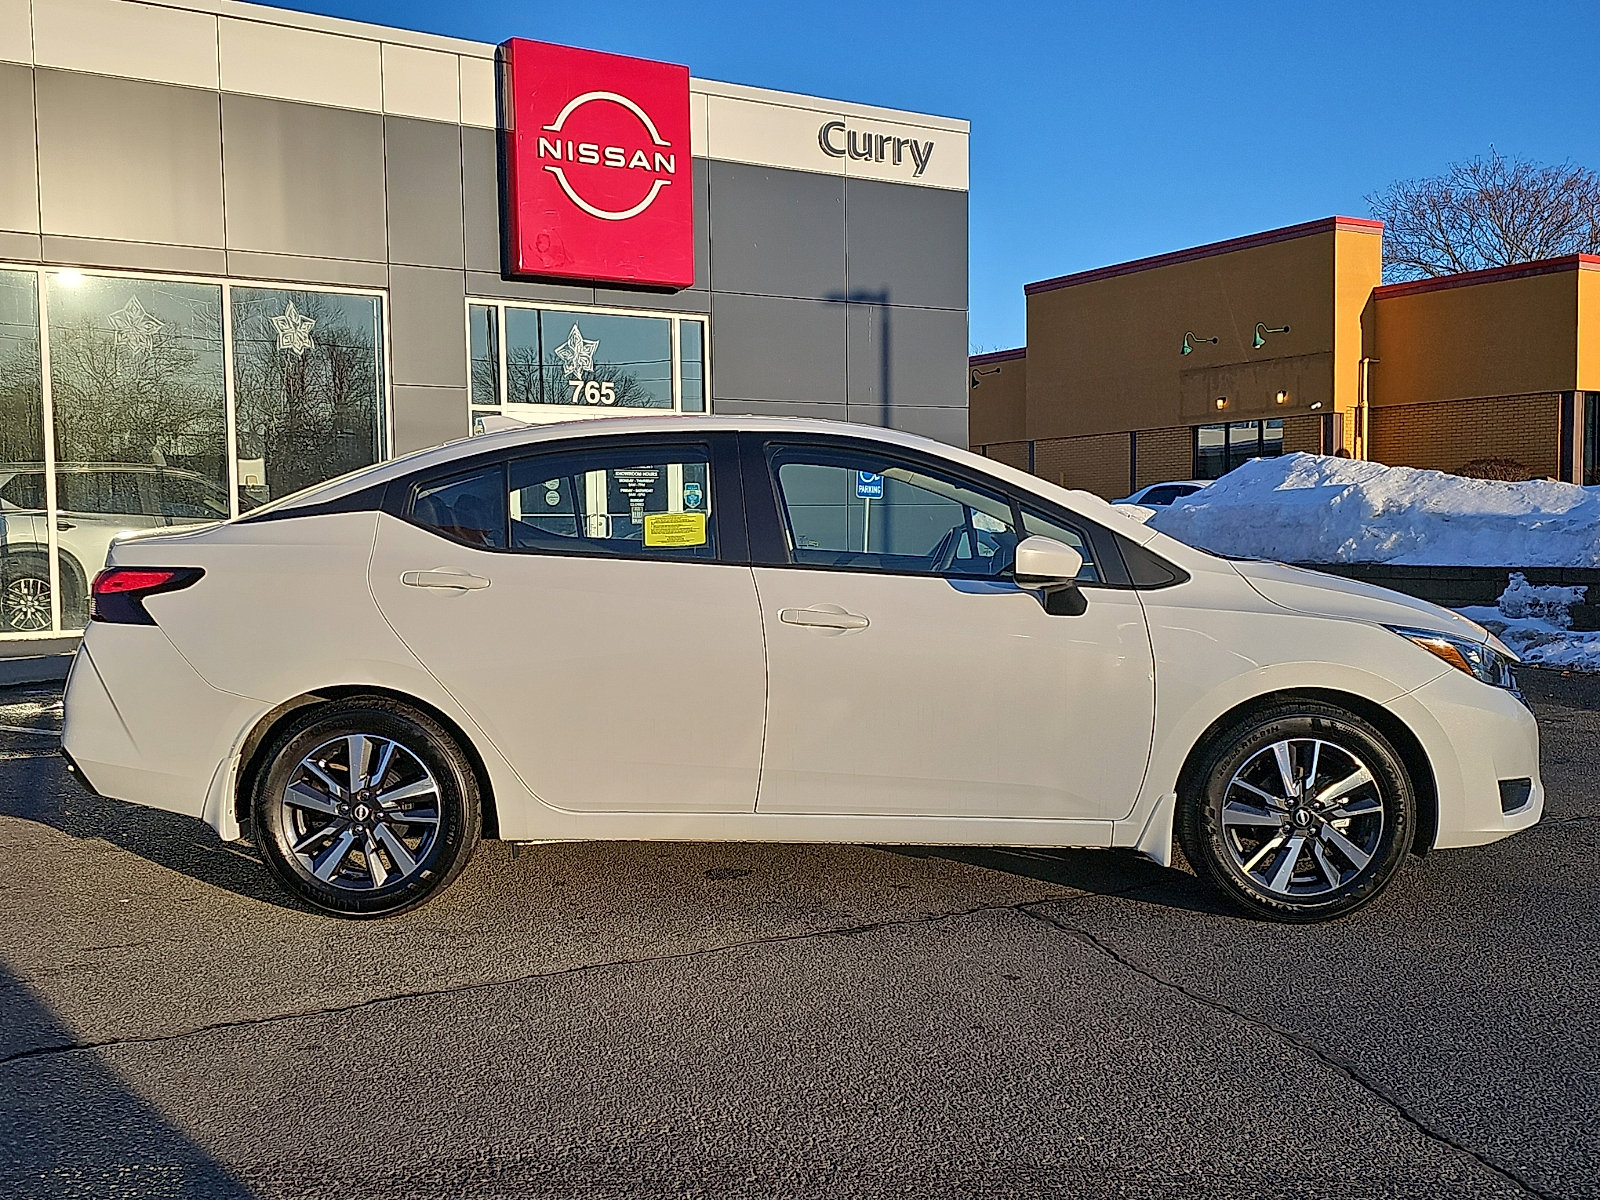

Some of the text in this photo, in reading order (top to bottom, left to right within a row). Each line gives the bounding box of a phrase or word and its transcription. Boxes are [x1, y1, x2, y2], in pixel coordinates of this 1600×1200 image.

[537, 136, 677, 174] NISSAN
[818, 120, 935, 178] Curry
[568, 379, 616, 405] 765
[858, 485, 882, 494] PARKING
